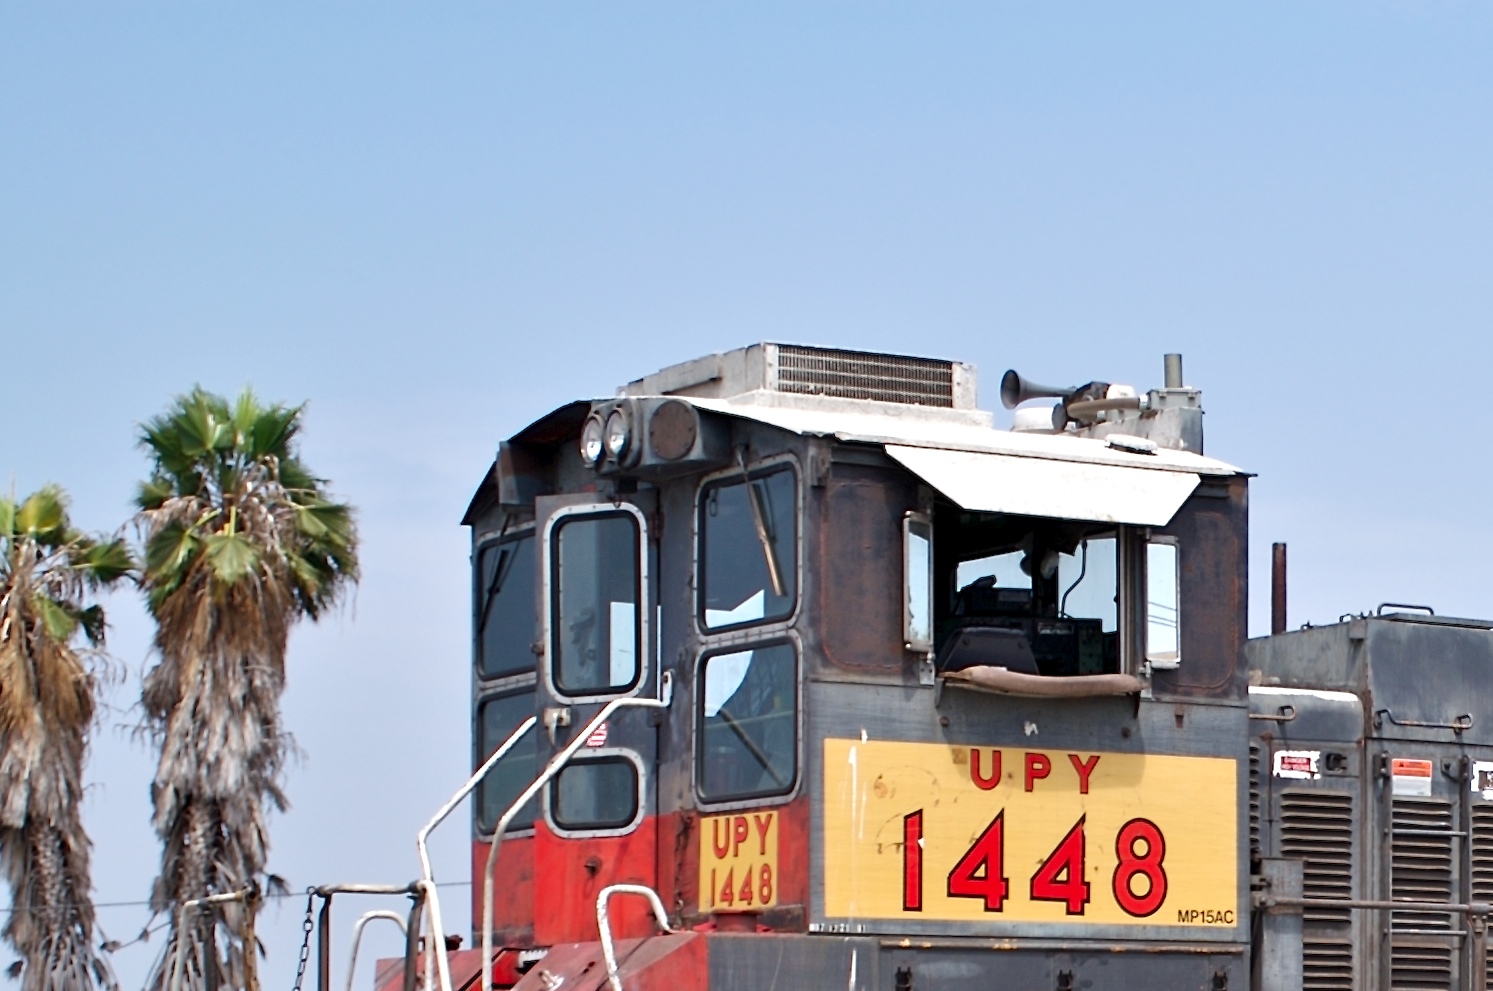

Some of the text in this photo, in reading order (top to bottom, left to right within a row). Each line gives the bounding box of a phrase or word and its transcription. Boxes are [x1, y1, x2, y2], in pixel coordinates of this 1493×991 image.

[970, 749, 1100, 794] UPY
[713, 812, 773, 860] UPY
[902, 807, 1169, 918] 1448
[710, 863, 772, 908] 1448
[1177, 909, 1234, 924] MP15AC
